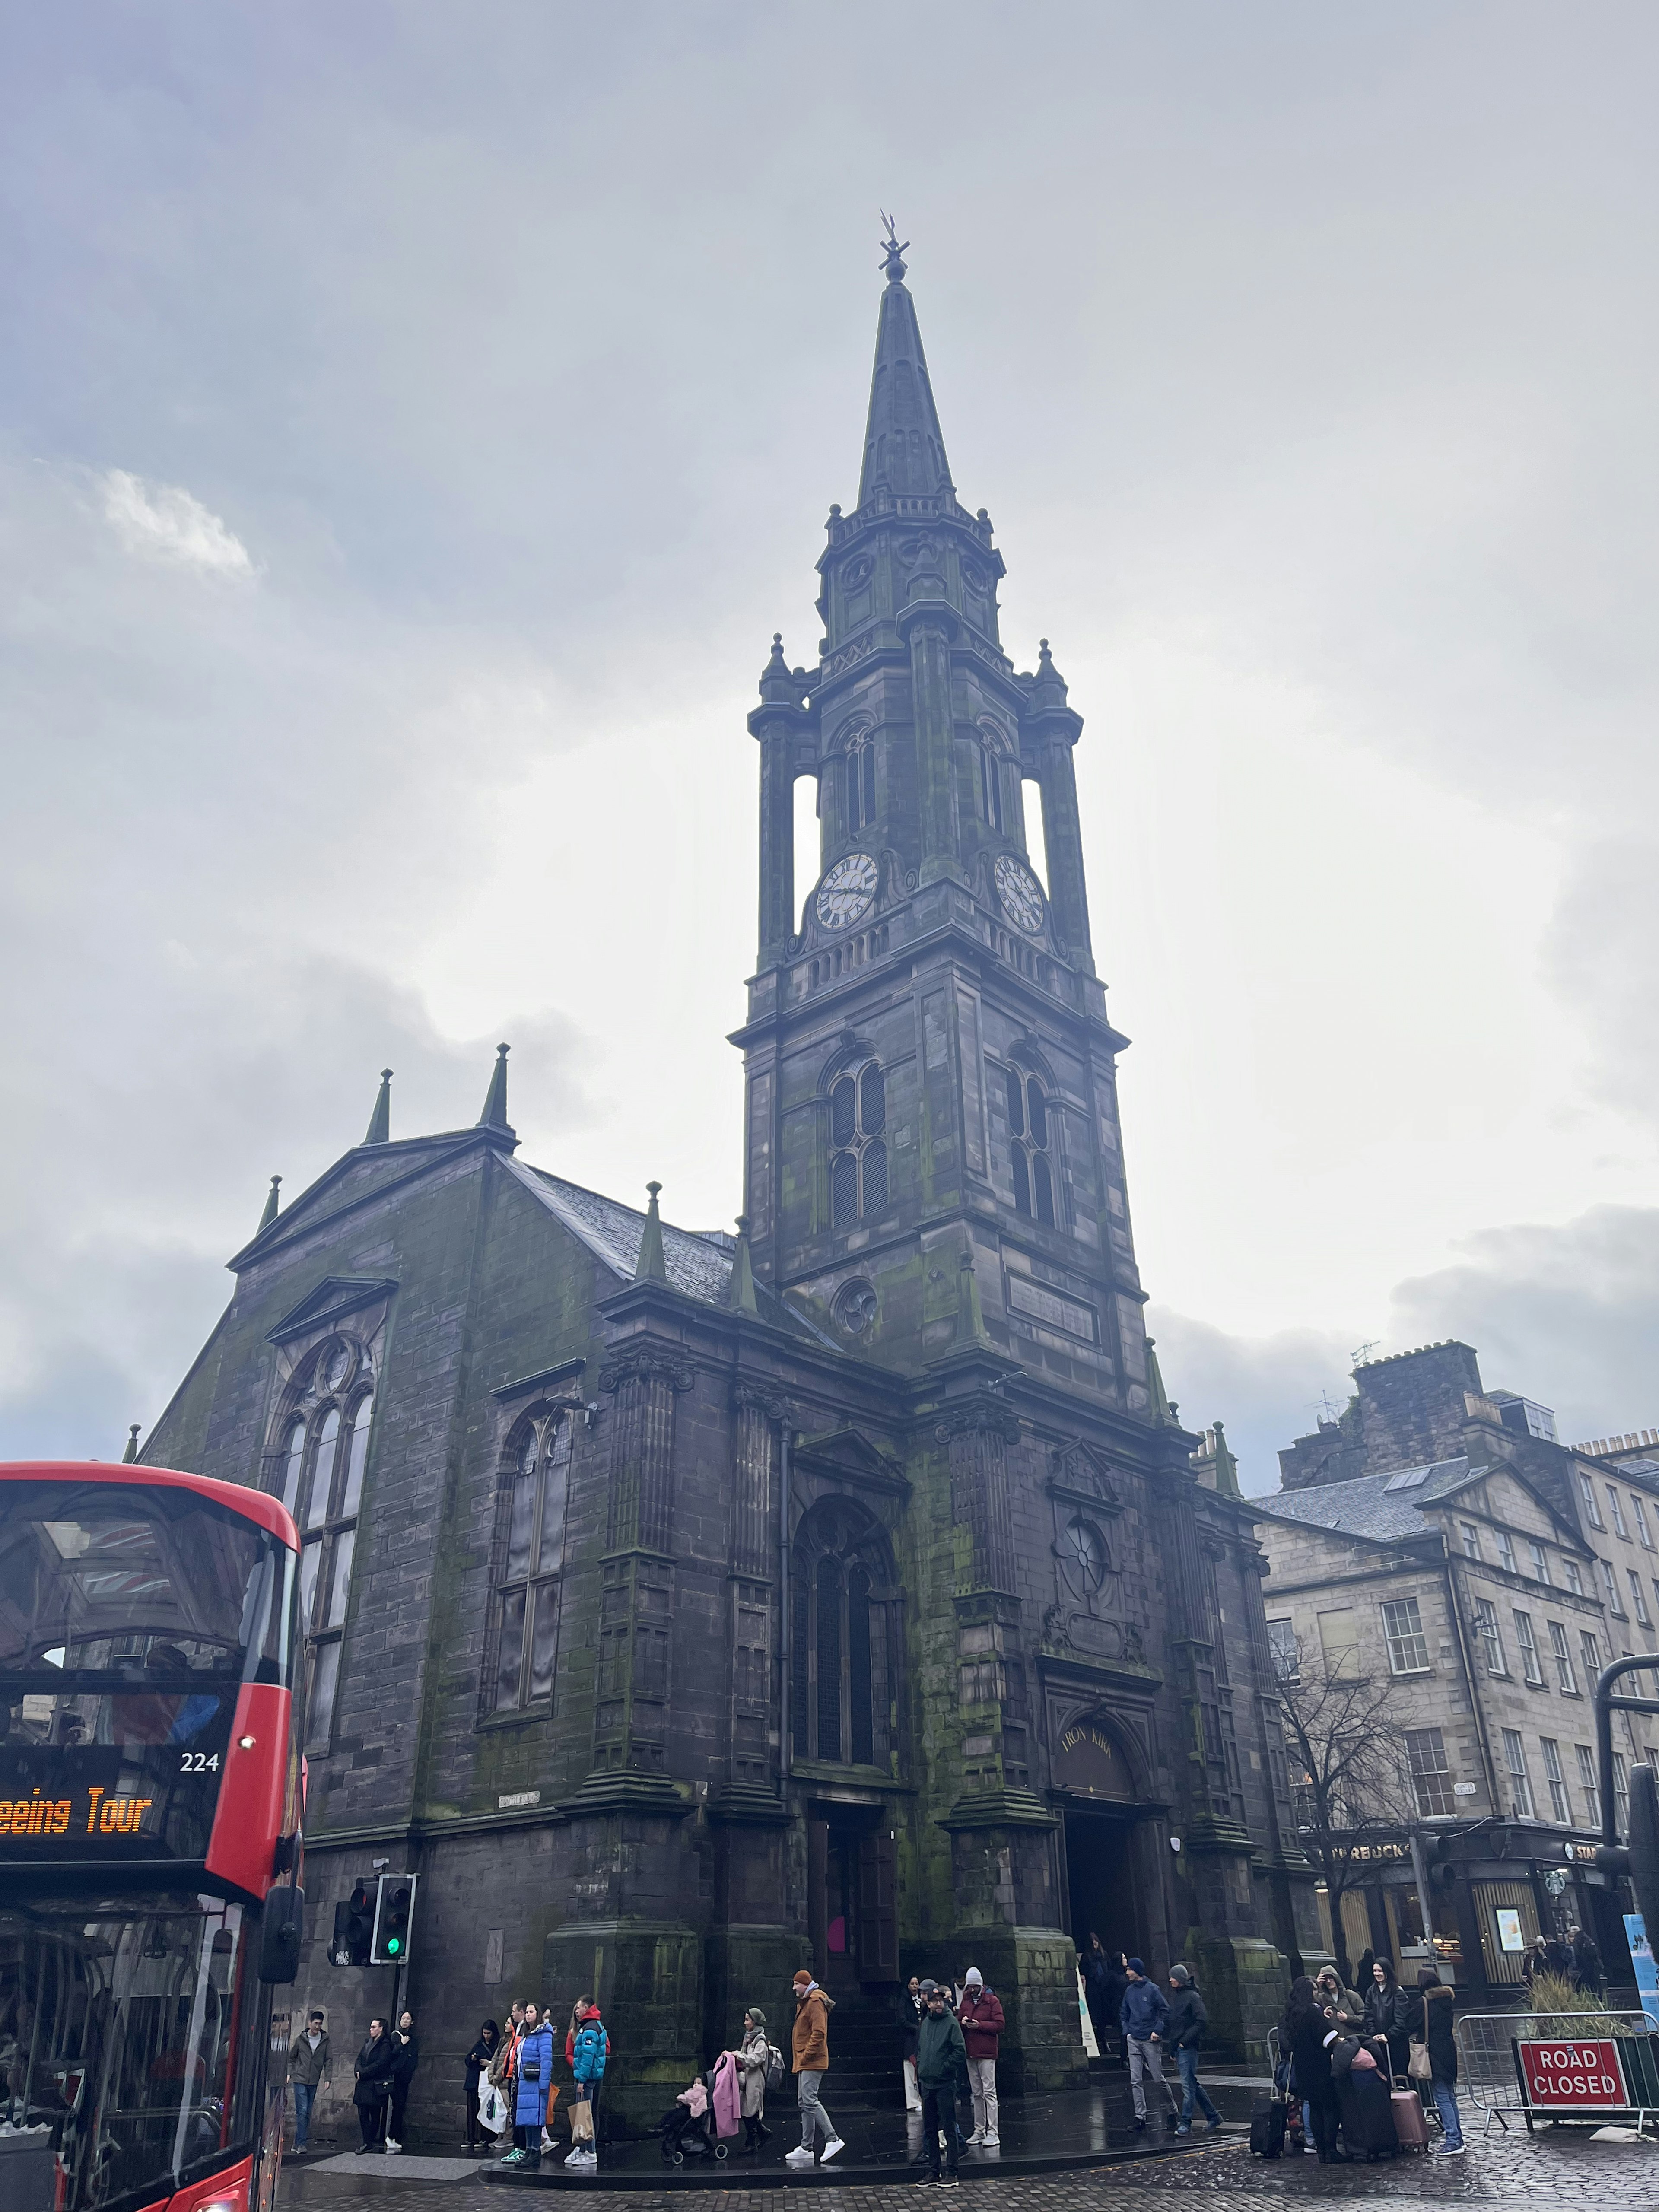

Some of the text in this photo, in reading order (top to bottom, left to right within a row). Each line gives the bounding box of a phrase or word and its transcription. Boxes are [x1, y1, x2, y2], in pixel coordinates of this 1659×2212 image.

[1092, 1727, 1112, 1759] KIRK
[179, 1753, 219, 1772] 224
[86, 1787, 153, 1833] Tour
[1539, 2050, 1597, 2069] ROAD
[1534, 2075, 1616, 2094] CLOSED
